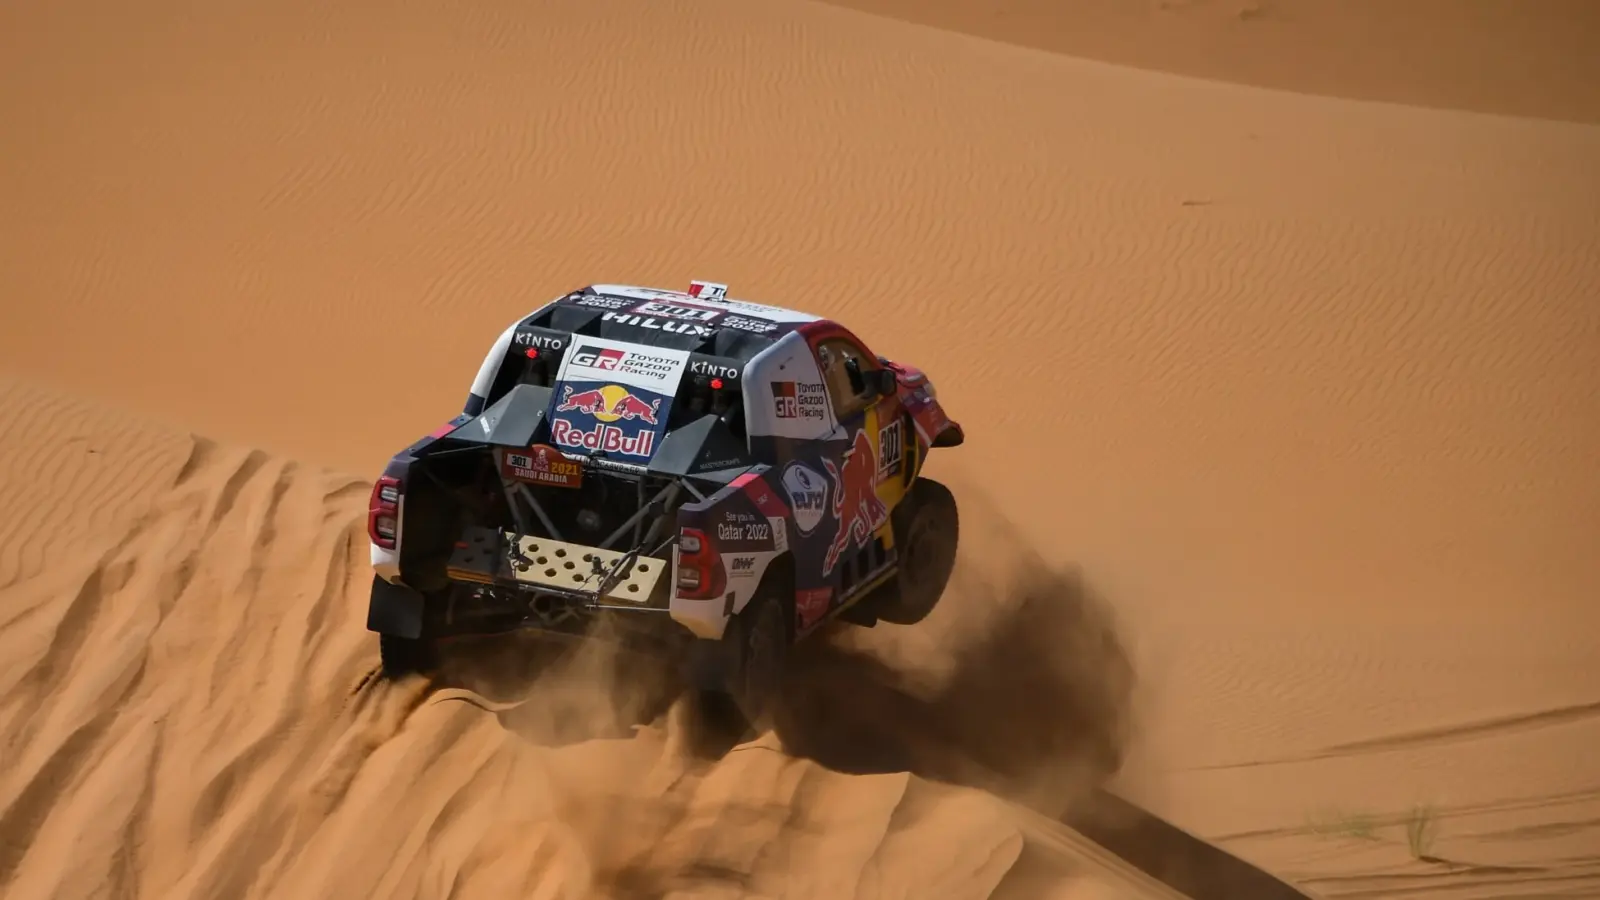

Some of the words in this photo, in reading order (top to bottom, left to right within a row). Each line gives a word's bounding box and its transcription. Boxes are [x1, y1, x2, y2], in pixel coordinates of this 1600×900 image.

[645, 303, 708, 317] 301
[601, 311, 713, 337] HILUX
[571, 352, 618, 370] GR
[623, 359, 672, 373] GAZOO
[629, 352, 680, 366] TOYOTA
[619, 365, 668, 380] Racing
[797, 382, 825, 393] TOYOTA
[798, 394, 824, 405] GAZOO
[798, 406, 824, 420] Racing
[551, 418, 603, 450] Red
[602, 424, 655, 457] Bull
[880, 423, 899, 468] 301
[511, 455, 528, 467] 301
[514, 468, 537, 479] SAUDI
[538, 473, 568, 484] ARABIA
[552, 462, 579, 476] 2021
[725, 511, 737, 521] See
[717, 523, 743, 540] Qatar
[745, 523, 768, 540] 2022
